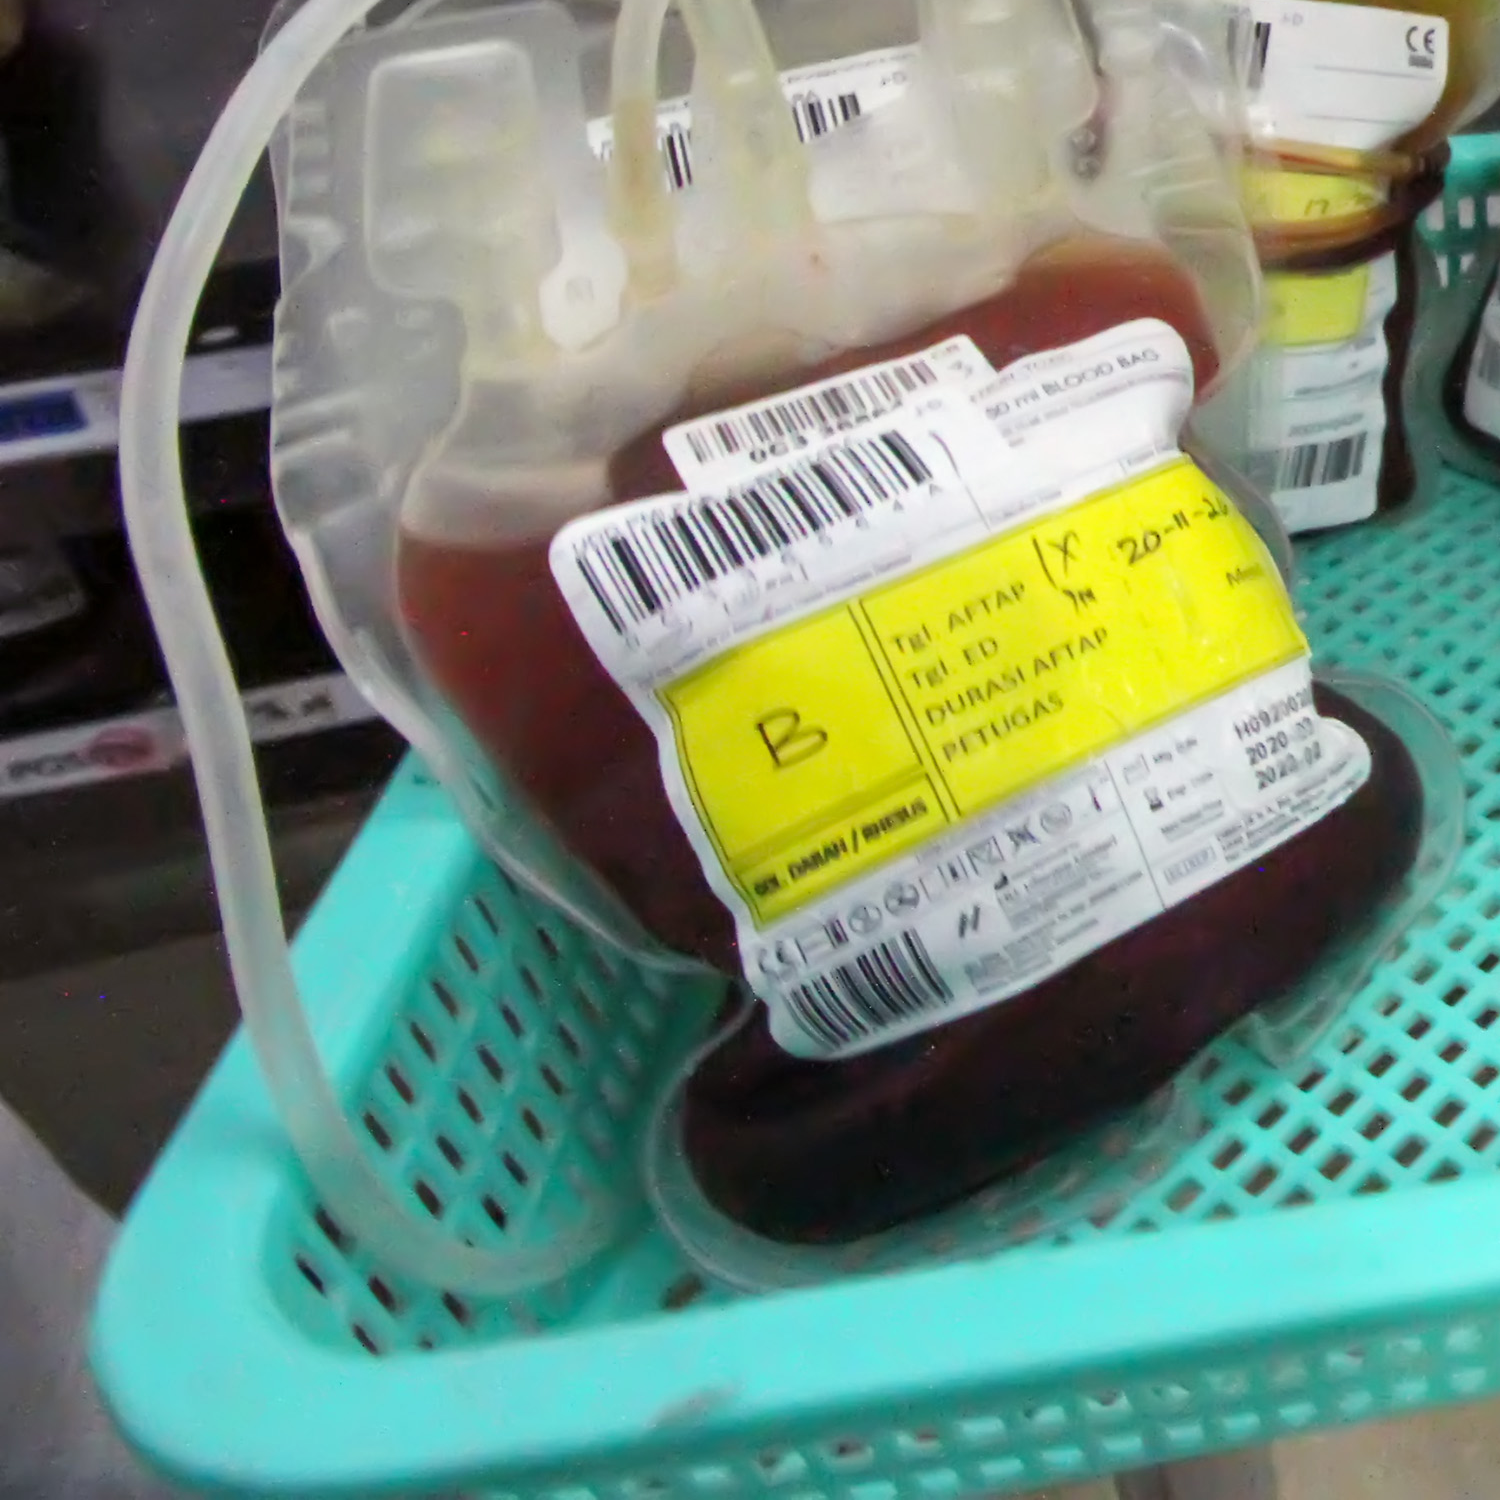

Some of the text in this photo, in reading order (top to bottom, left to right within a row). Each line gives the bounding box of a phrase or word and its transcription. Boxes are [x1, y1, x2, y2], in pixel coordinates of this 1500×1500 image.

[1041, 360, 1115, 399] BLOOD
[1117, 347, 1161, 375] BAG
[948, 580, 1026, 634] AFTAP
[924, 626, 1109, 727] DURASI AFTAP
[962, 635, 998, 666] ED
[756, 706, 829, 768] B
[940, 690, 1065, 763] PETUGAS
